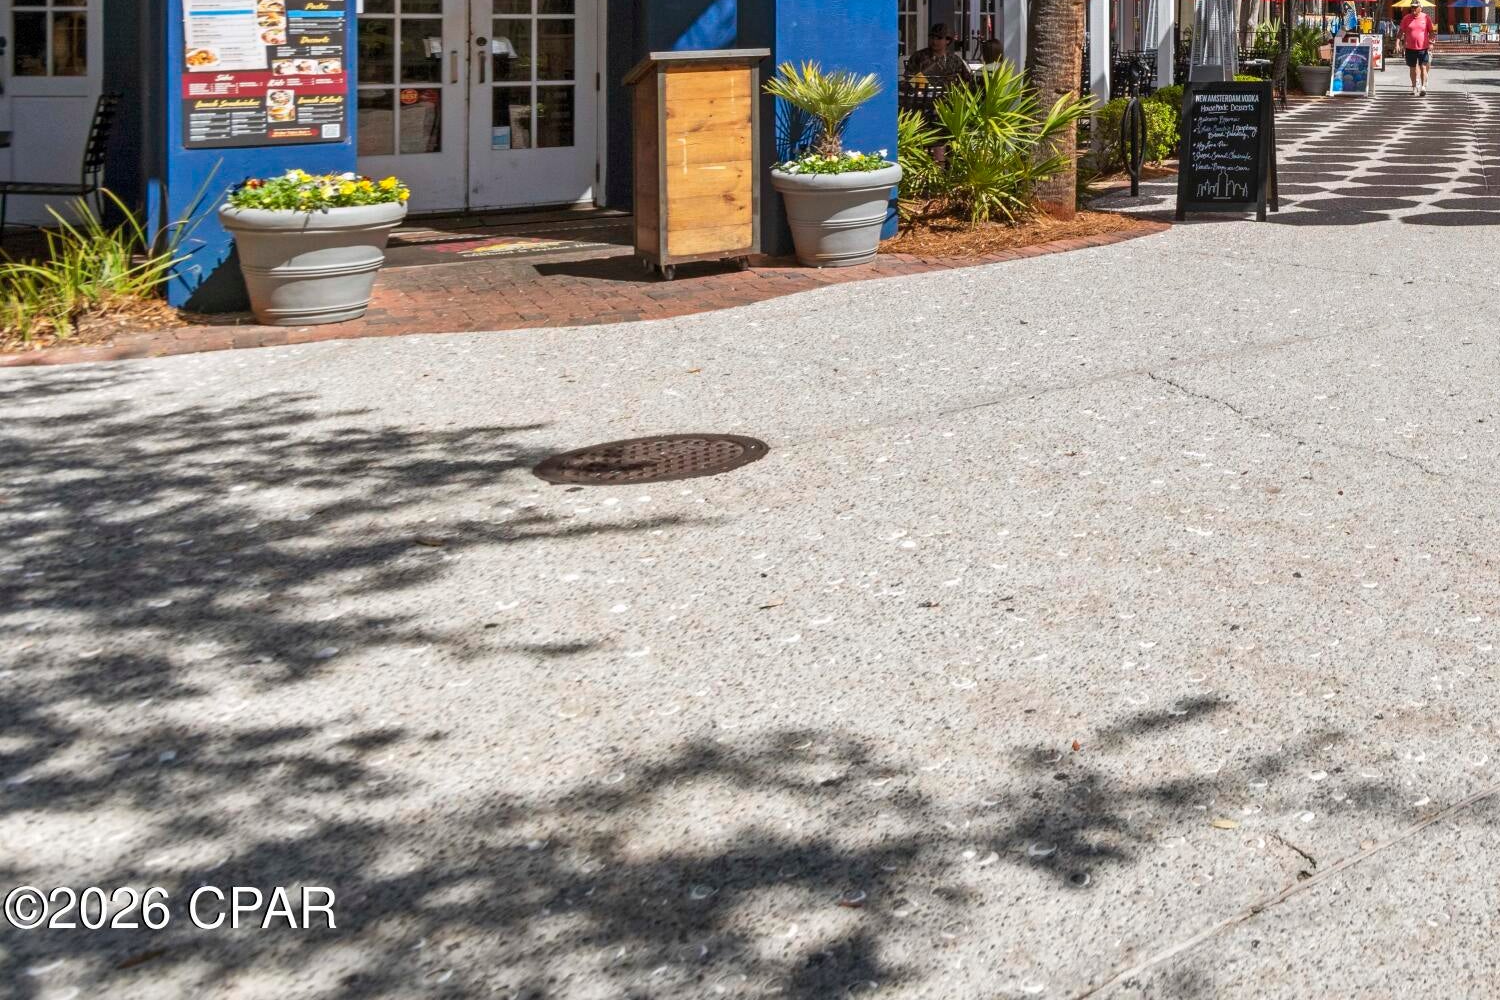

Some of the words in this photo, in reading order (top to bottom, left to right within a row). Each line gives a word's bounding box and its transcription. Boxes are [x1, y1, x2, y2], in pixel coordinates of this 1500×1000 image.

[1195, 94, 1207, 102] NEW
[1208, 94, 1240, 102] AMSTERDAM
[1241, 94, 1259, 102] VODKA
